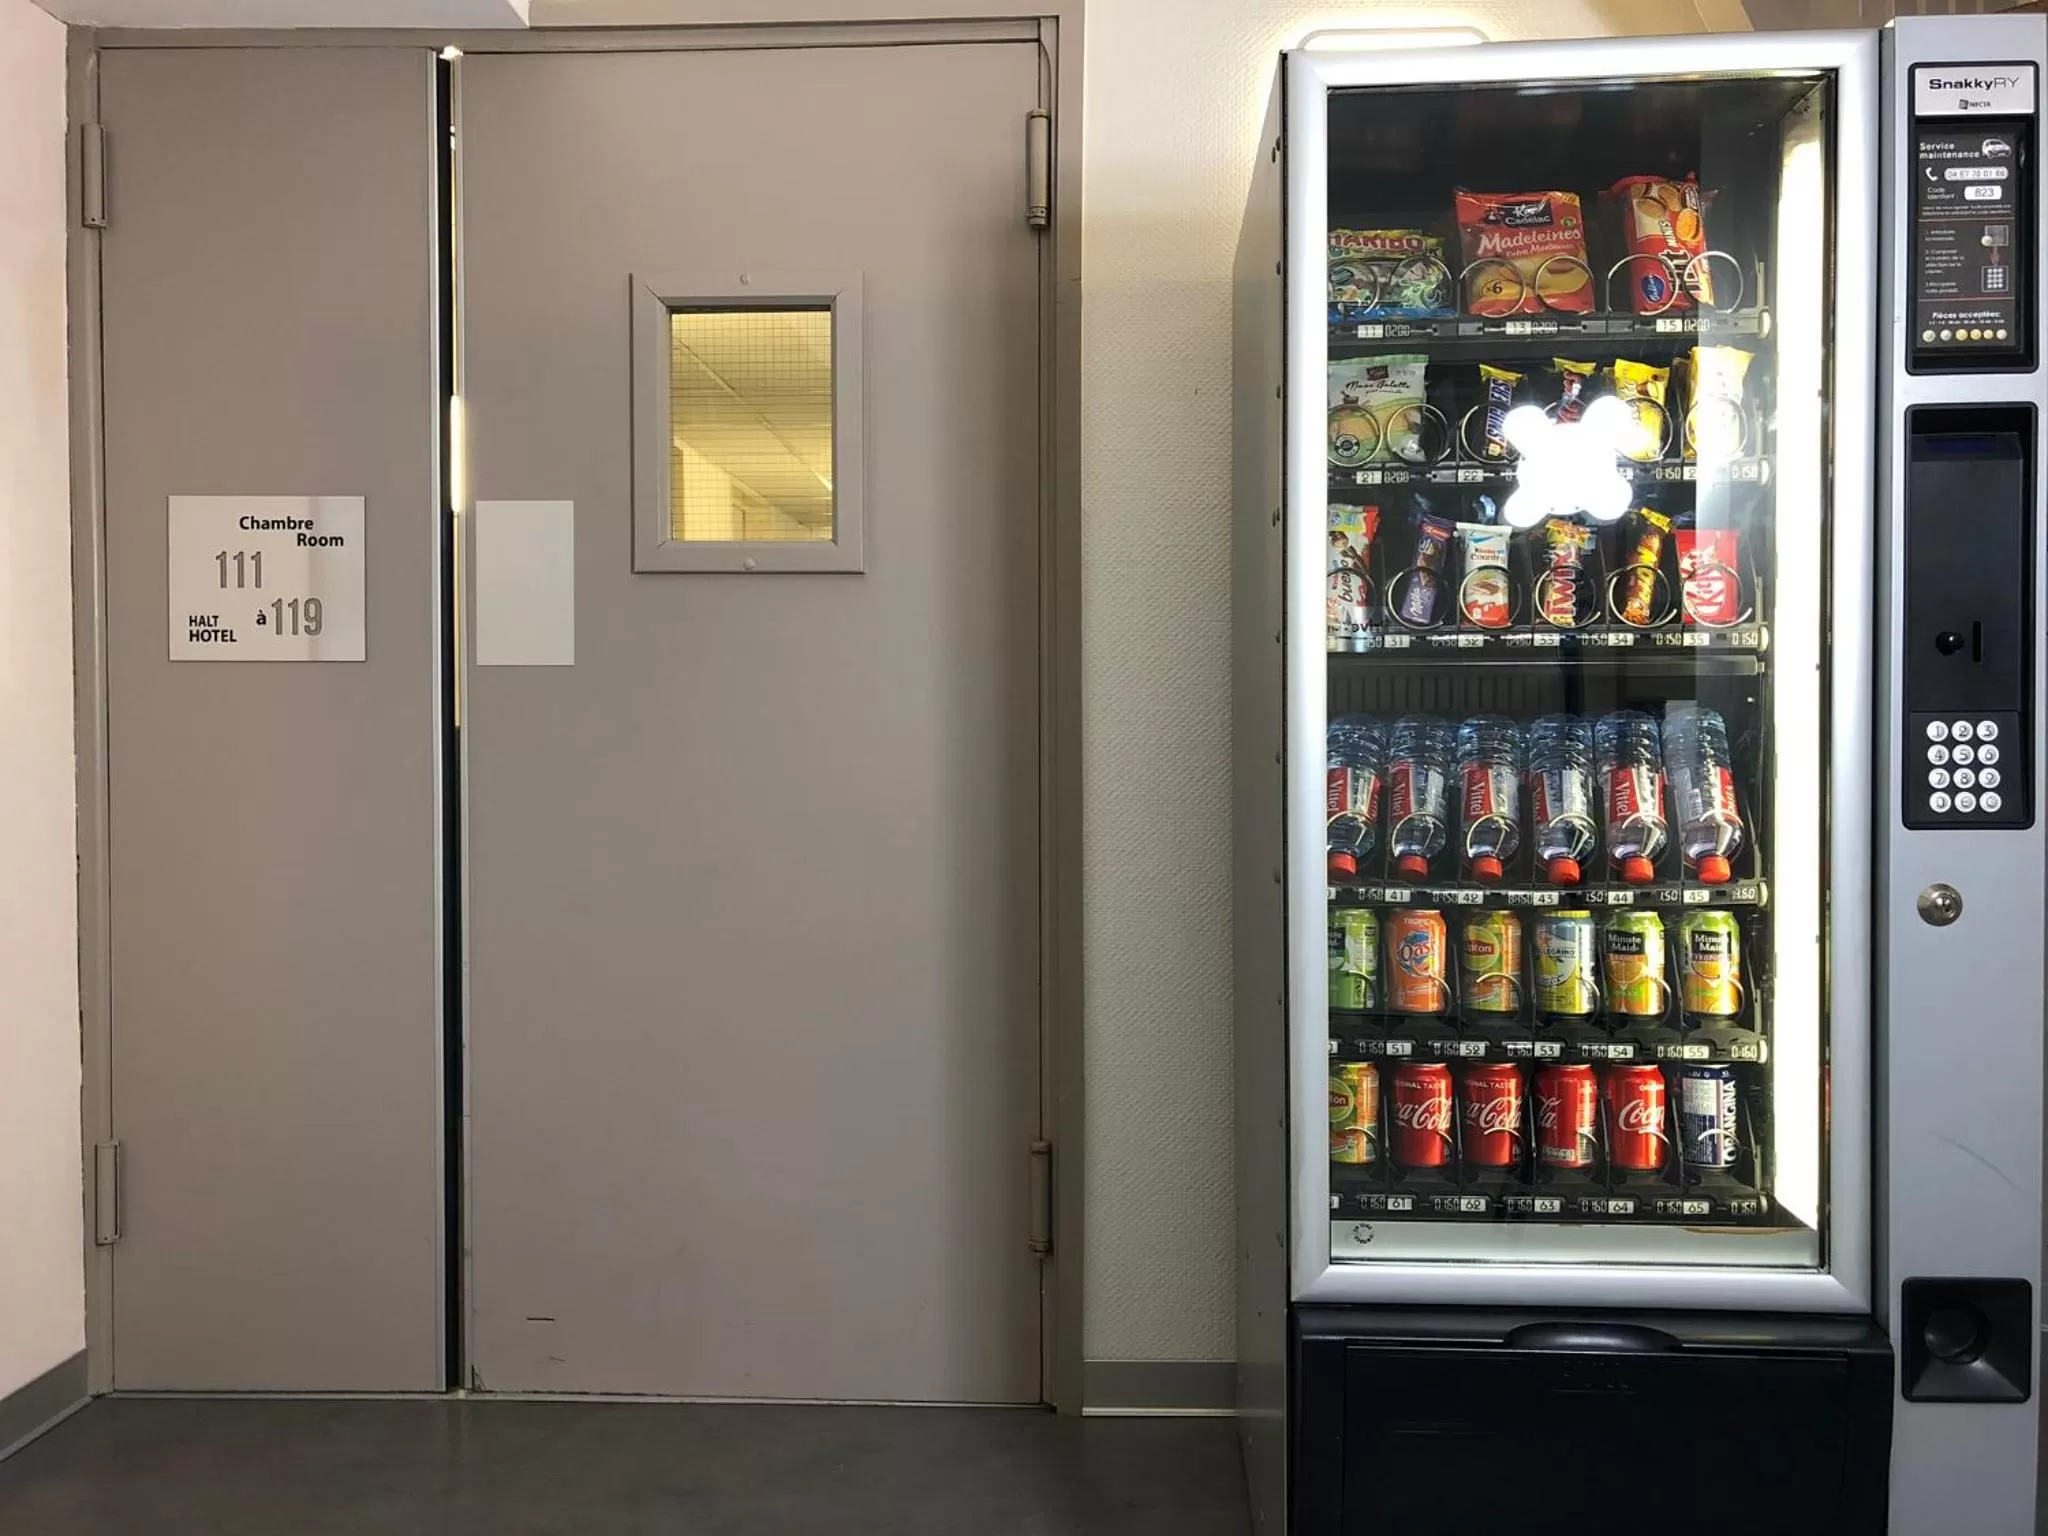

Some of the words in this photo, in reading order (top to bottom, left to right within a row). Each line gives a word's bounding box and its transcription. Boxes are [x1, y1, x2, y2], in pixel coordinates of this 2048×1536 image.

[1919, 142, 1955, 151] Service
[1919, 151, 1980, 160] maintenance
[1477, 230, 1582, 256] Madeleines
[1662, 320, 1677, 331] 15
[1362, 472, 1375, 483] 21
[239, 516, 314, 530] Chambre
[297, 533, 345, 548] Room
[215, 551, 263, 589] 111
[188, 615, 219, 627] HALT
[256, 610, 266, 626] à
[271, 598, 323, 636] 119
[188, 629, 237, 643] HOTEL
[1613, 634, 1628, 645] 34
[1689, 635, 1704, 645] 35
[1958, 724, 1968, 737] 2
[1983, 724, 1993, 737] 3
[1934, 749, 1943, 762] 4
[1959, 748, 1969, 761] 5
[1984, 748, 1993, 761] 6
[1935, 772, 1944, 785] 7
[1959, 772, 1969, 785] 8
[1985, 772, 1994, 785] 9
[1470, 780, 1487, 815] Vittel
[1615, 782, 1633, 817] Vittel
[1390, 891, 1404, 901] 41
[1464, 892, 1478, 902] 42
[1539, 893, 1553, 902] 43
[1613, 893, 1628, 902] 44
[1689, 891, 1704, 901] 45
[1608, 933, 1642, 944] Minute
[1611, 943, 1637, 952] Maid
[1392, 1045, 1406, 1054] 51
[1465, 1045, 1480, 1055] 52
[1540, 1047, 1555, 1056] 53
[1613, 1047, 1628, 1056] 54
[1689, 1047, 1704, 1057] 55
[1393, 1199, 1406, 1208] 61
[1465, 1200, 1480, 1209] 62
[1540, 1201, 1554, 1210] 63
[1613, 1202, 1629, 1211] 64
[1688, 1202, 1704, 1211] 65
